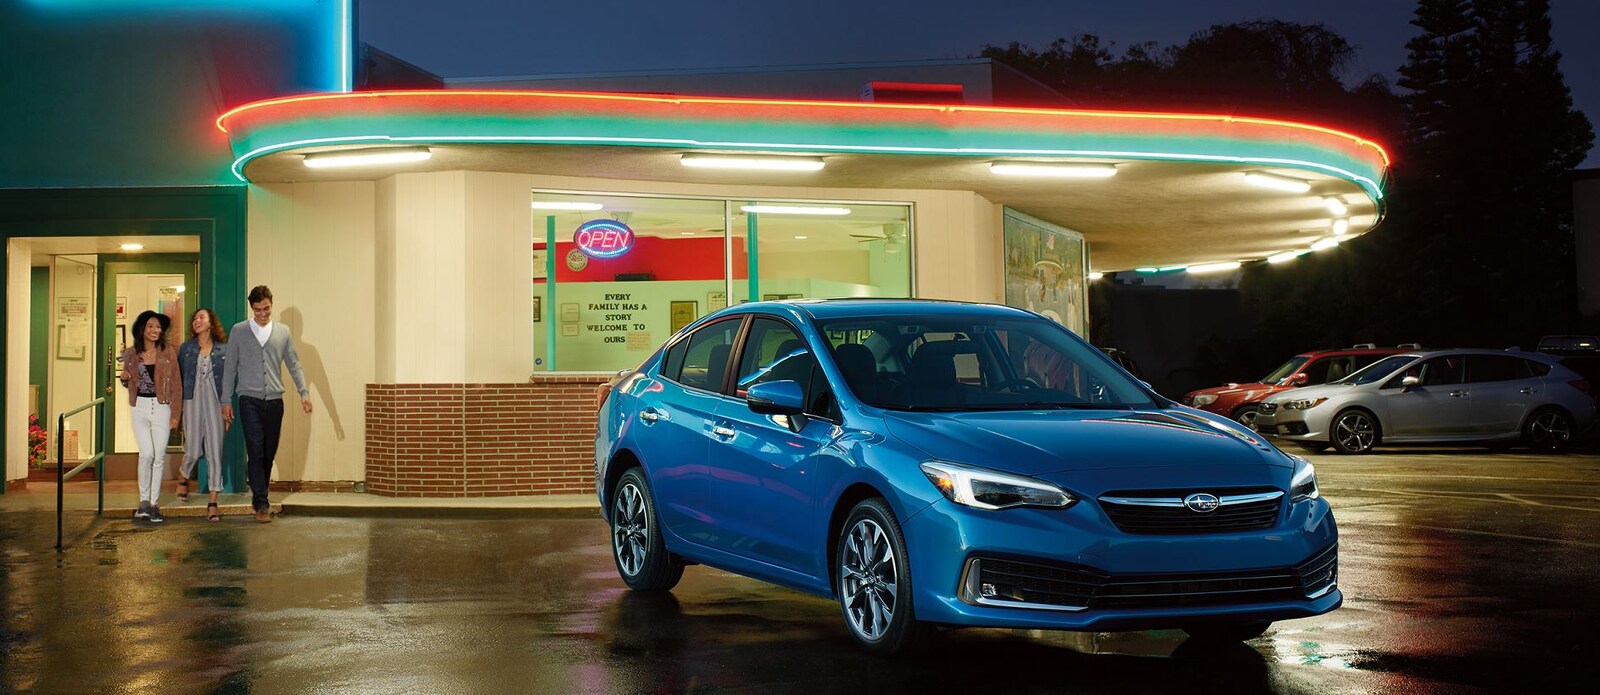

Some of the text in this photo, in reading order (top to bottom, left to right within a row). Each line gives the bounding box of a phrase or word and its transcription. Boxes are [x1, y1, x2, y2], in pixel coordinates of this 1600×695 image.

[578, 230, 630, 248] OPEN
[604, 293, 631, 301] EVERY
[588, 303, 648, 311] FAMILY HAS A
[605, 313, 632, 321] STORY
[586, 323, 646, 332] WELCOME TO
[603, 336, 626, 344] OURS
